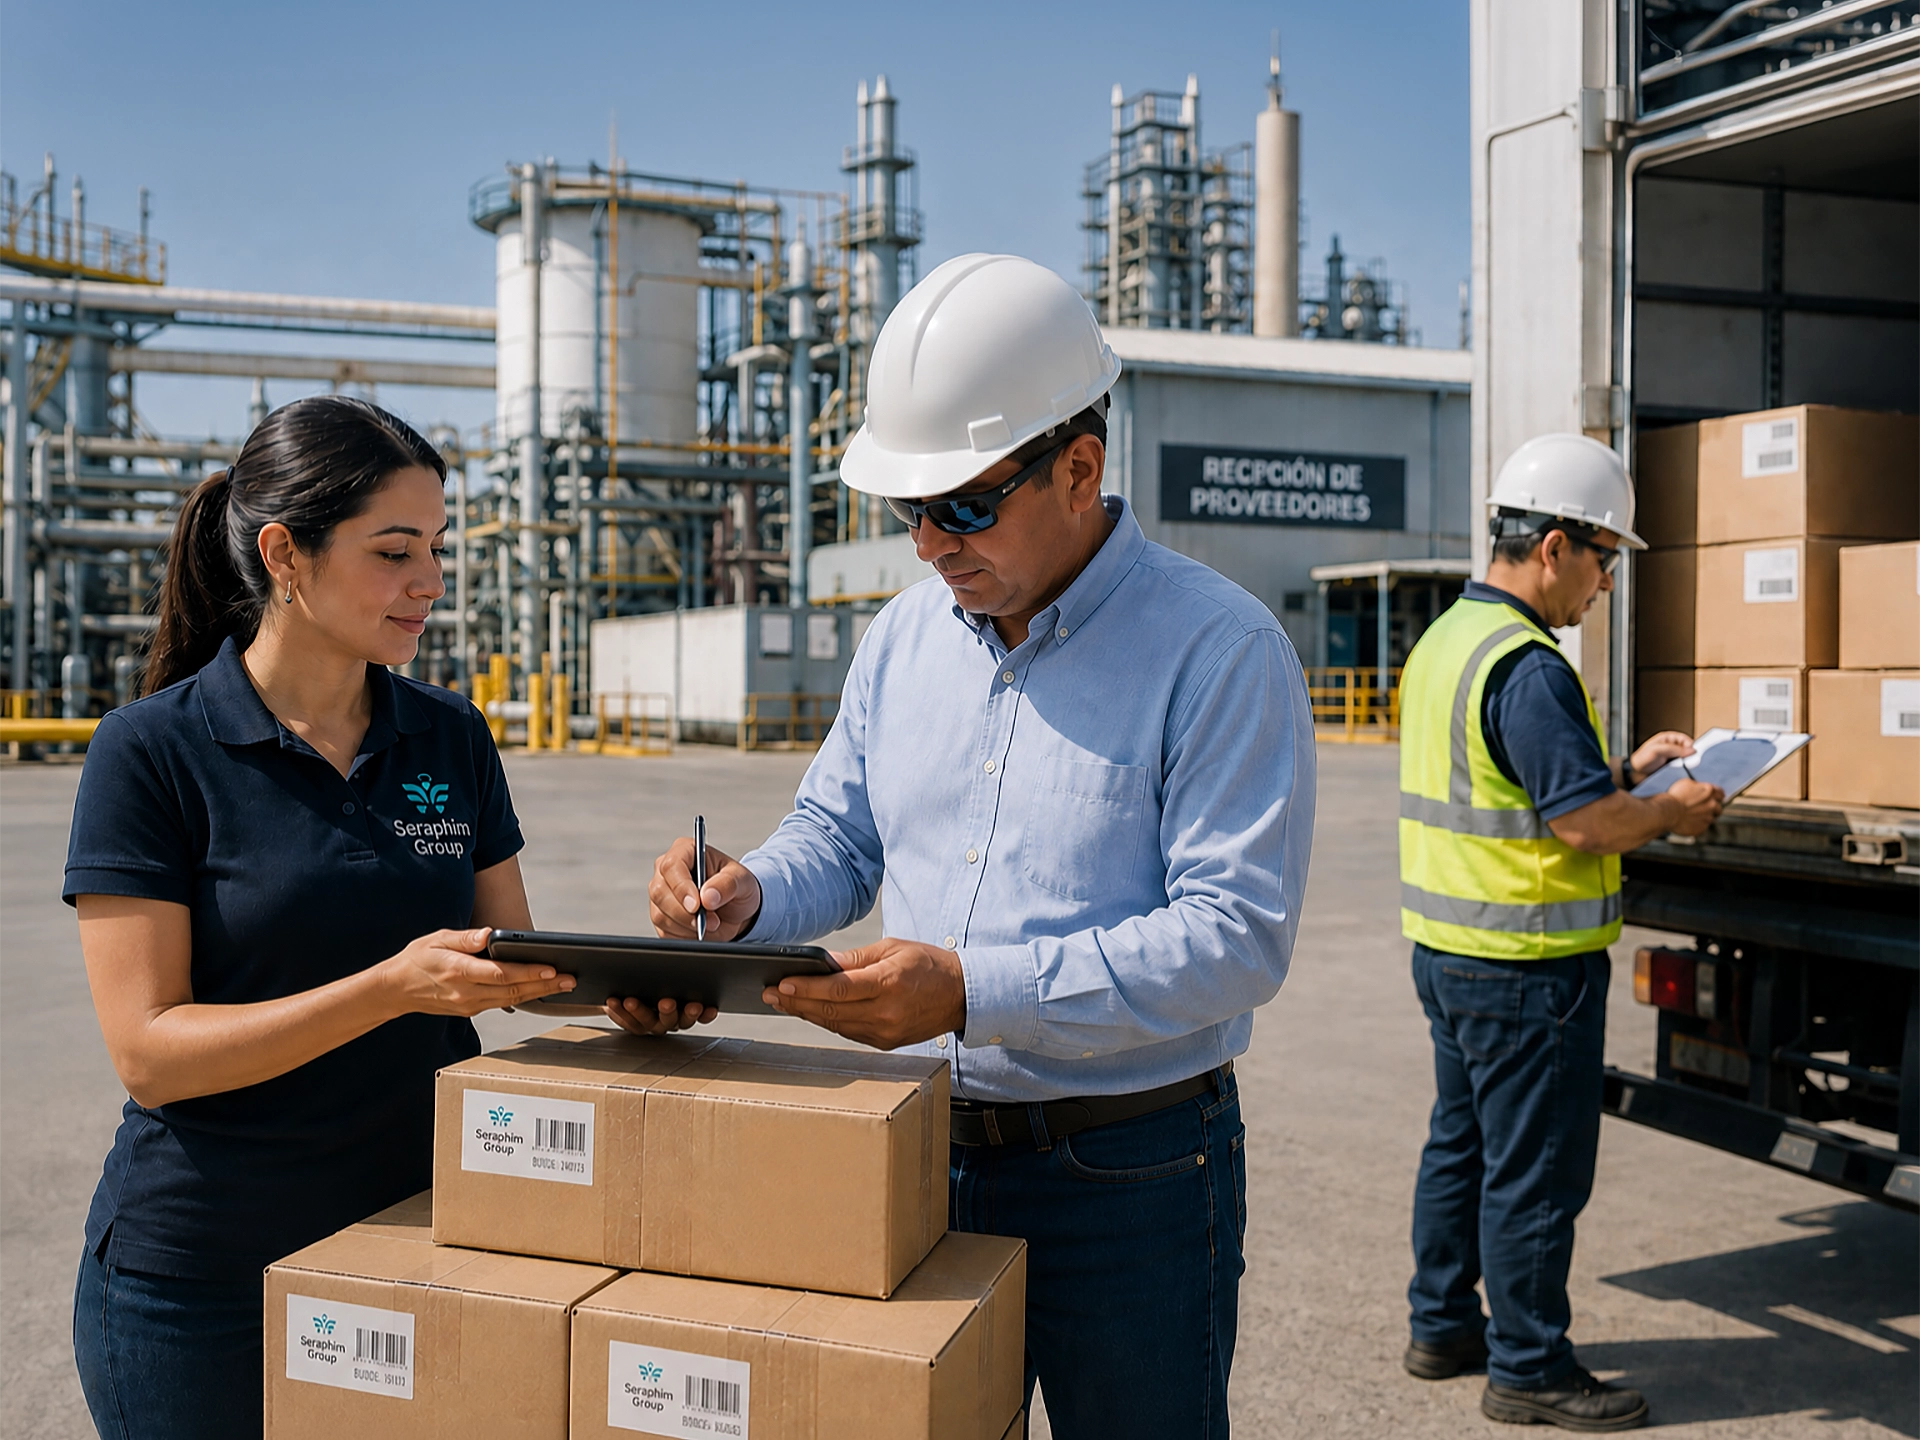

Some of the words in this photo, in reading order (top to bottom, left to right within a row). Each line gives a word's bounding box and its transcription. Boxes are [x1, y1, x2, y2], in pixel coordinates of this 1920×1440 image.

[1329, 463, 1364, 491] DE
[1190, 486, 1372, 522] PROVEEDORES
[393, 818, 471, 840] Seraphim
[414, 838, 464, 860] Group
[475, 1128, 524, 1144] Seraphim
[483, 1141, 514, 1156] Group
[300, 1335, 346, 1354] Seraphim
[307, 1348, 337, 1365] Group
[624, 1382, 673, 1401] Seraphim
[632, 1396, 664, 1413] Group
